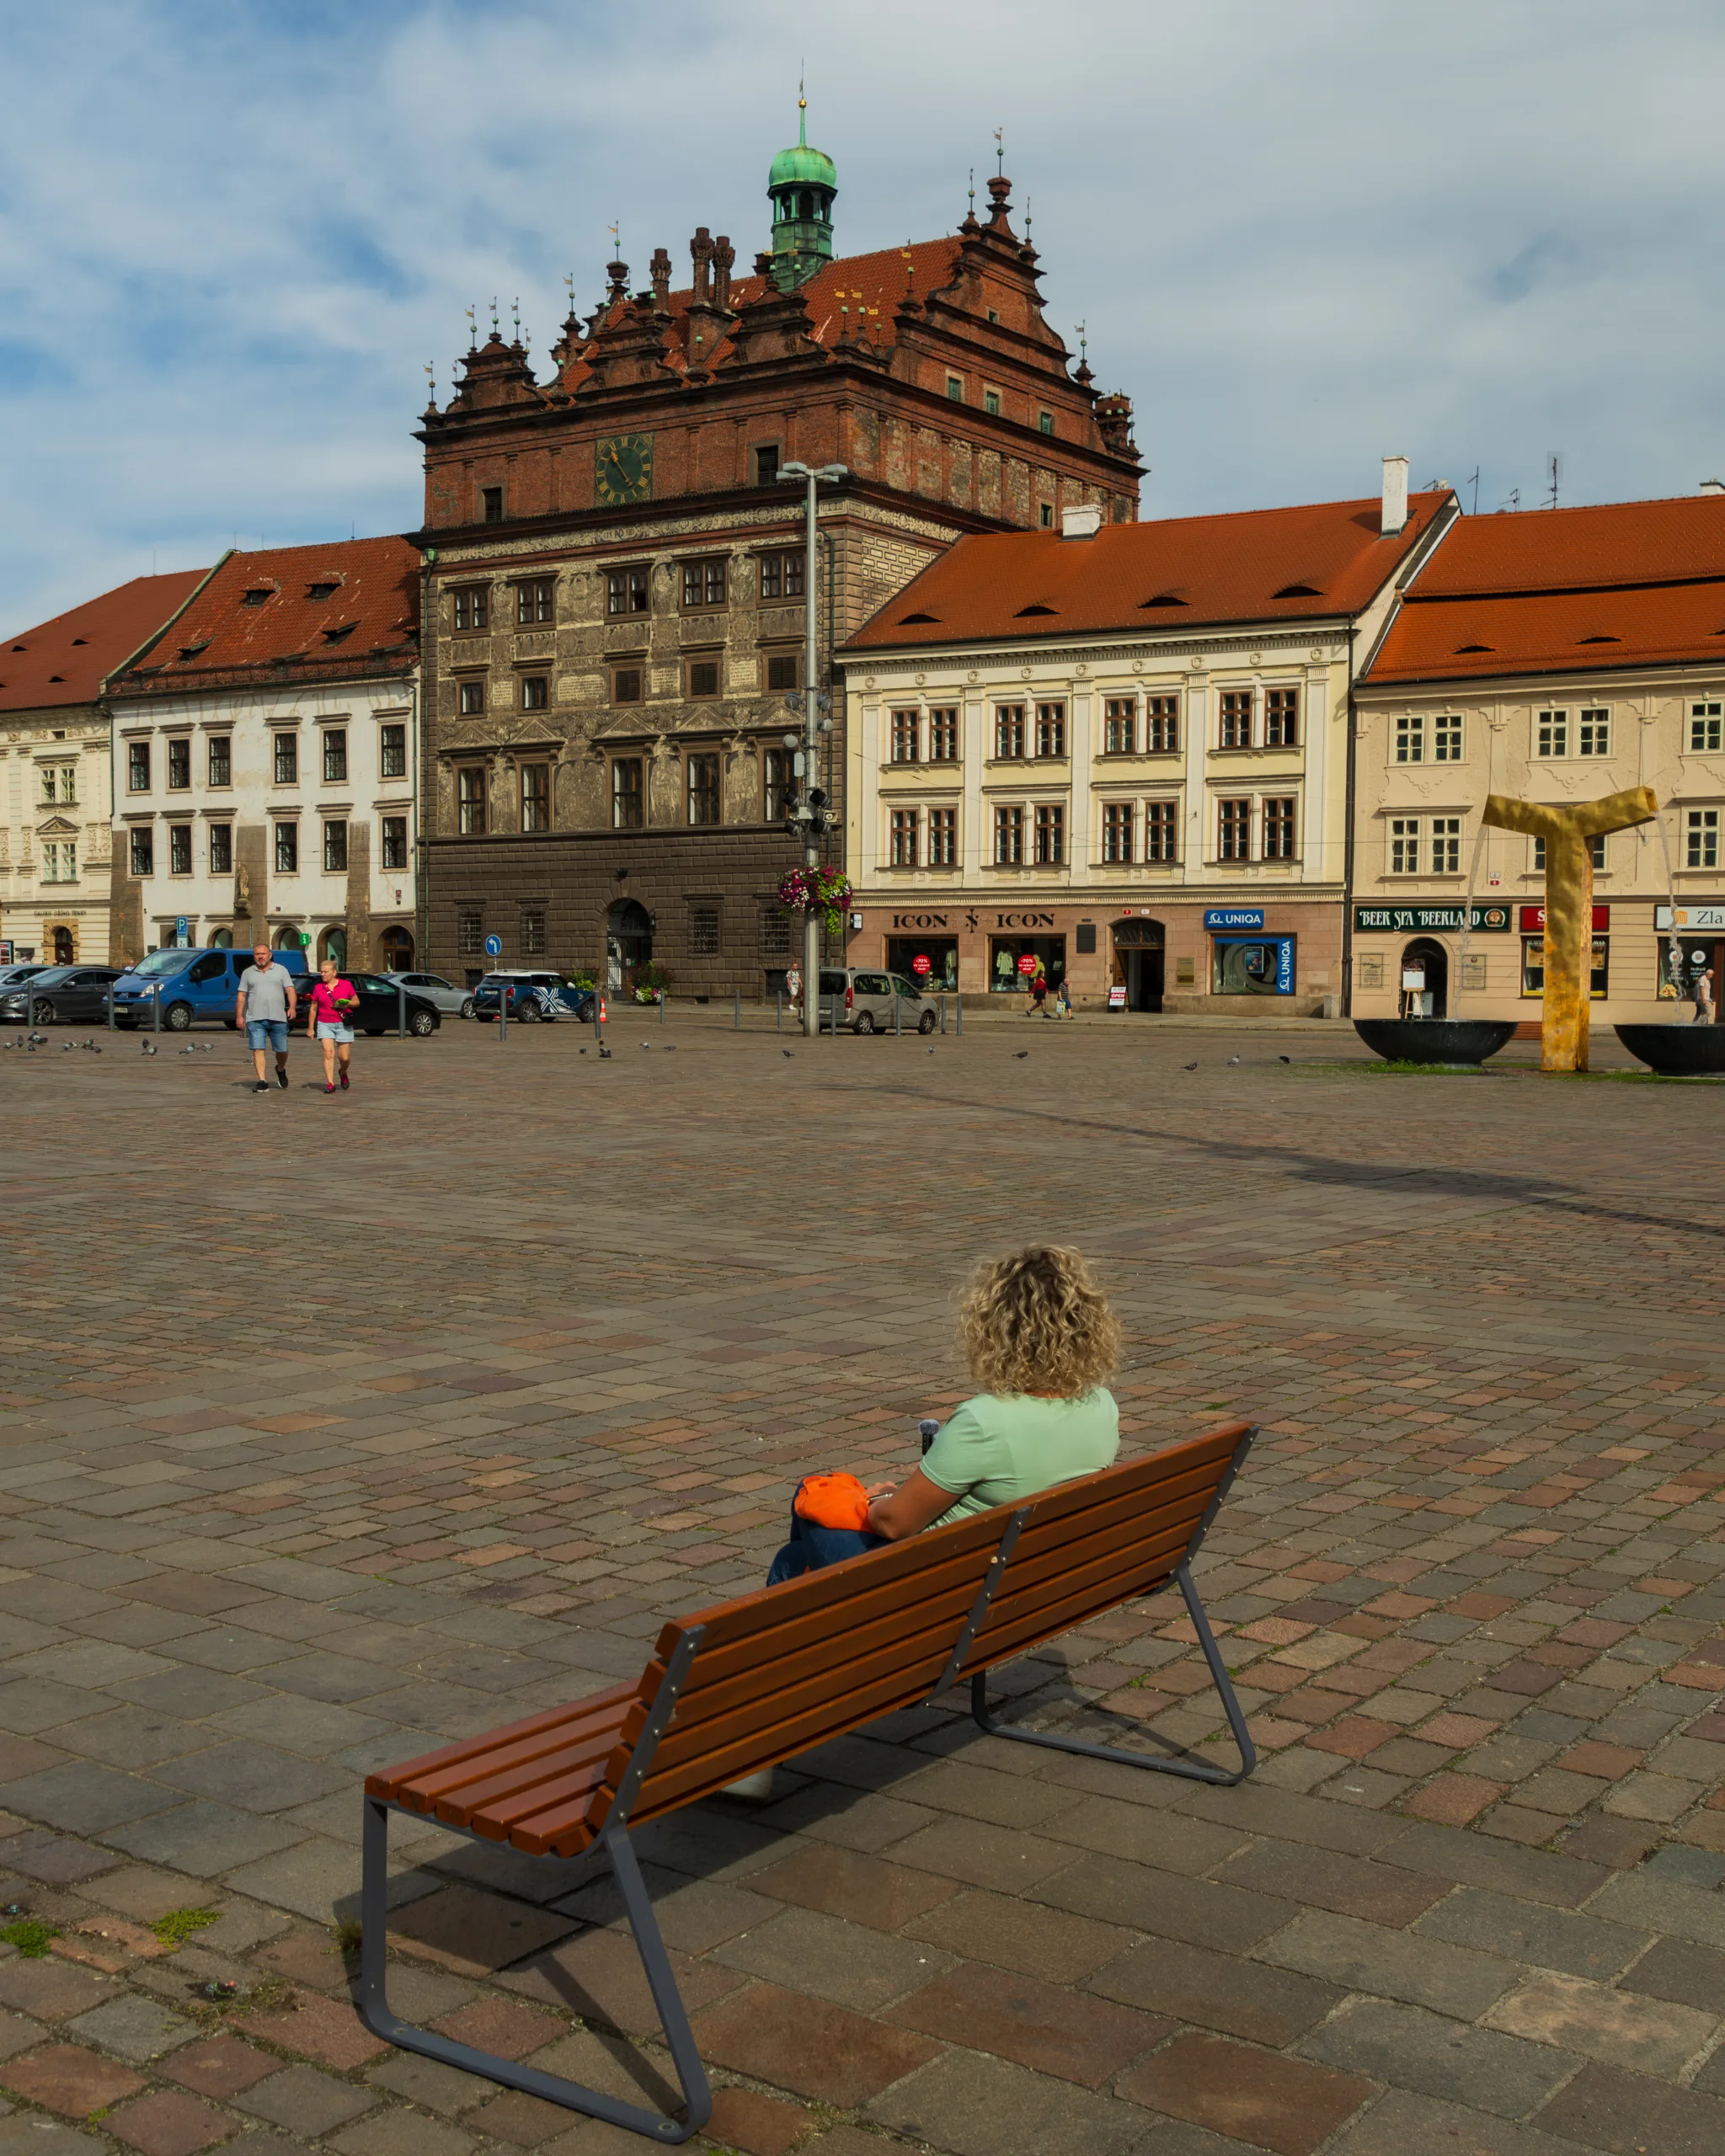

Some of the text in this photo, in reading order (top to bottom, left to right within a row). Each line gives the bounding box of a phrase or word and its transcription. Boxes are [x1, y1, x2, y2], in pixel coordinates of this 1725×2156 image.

[893, 915, 948, 928] ICON
[996, 914, 1055, 927] ICON
[1226, 914, 1261, 924] UNIQA
[1359, 911, 1391, 926] BEER
[1394, 910, 1414, 930] SPA
[1696, 910, 1725, 925] Zla
[179, 919, 185, 931] P
[1281, 941, 1290, 974] UNIQA
